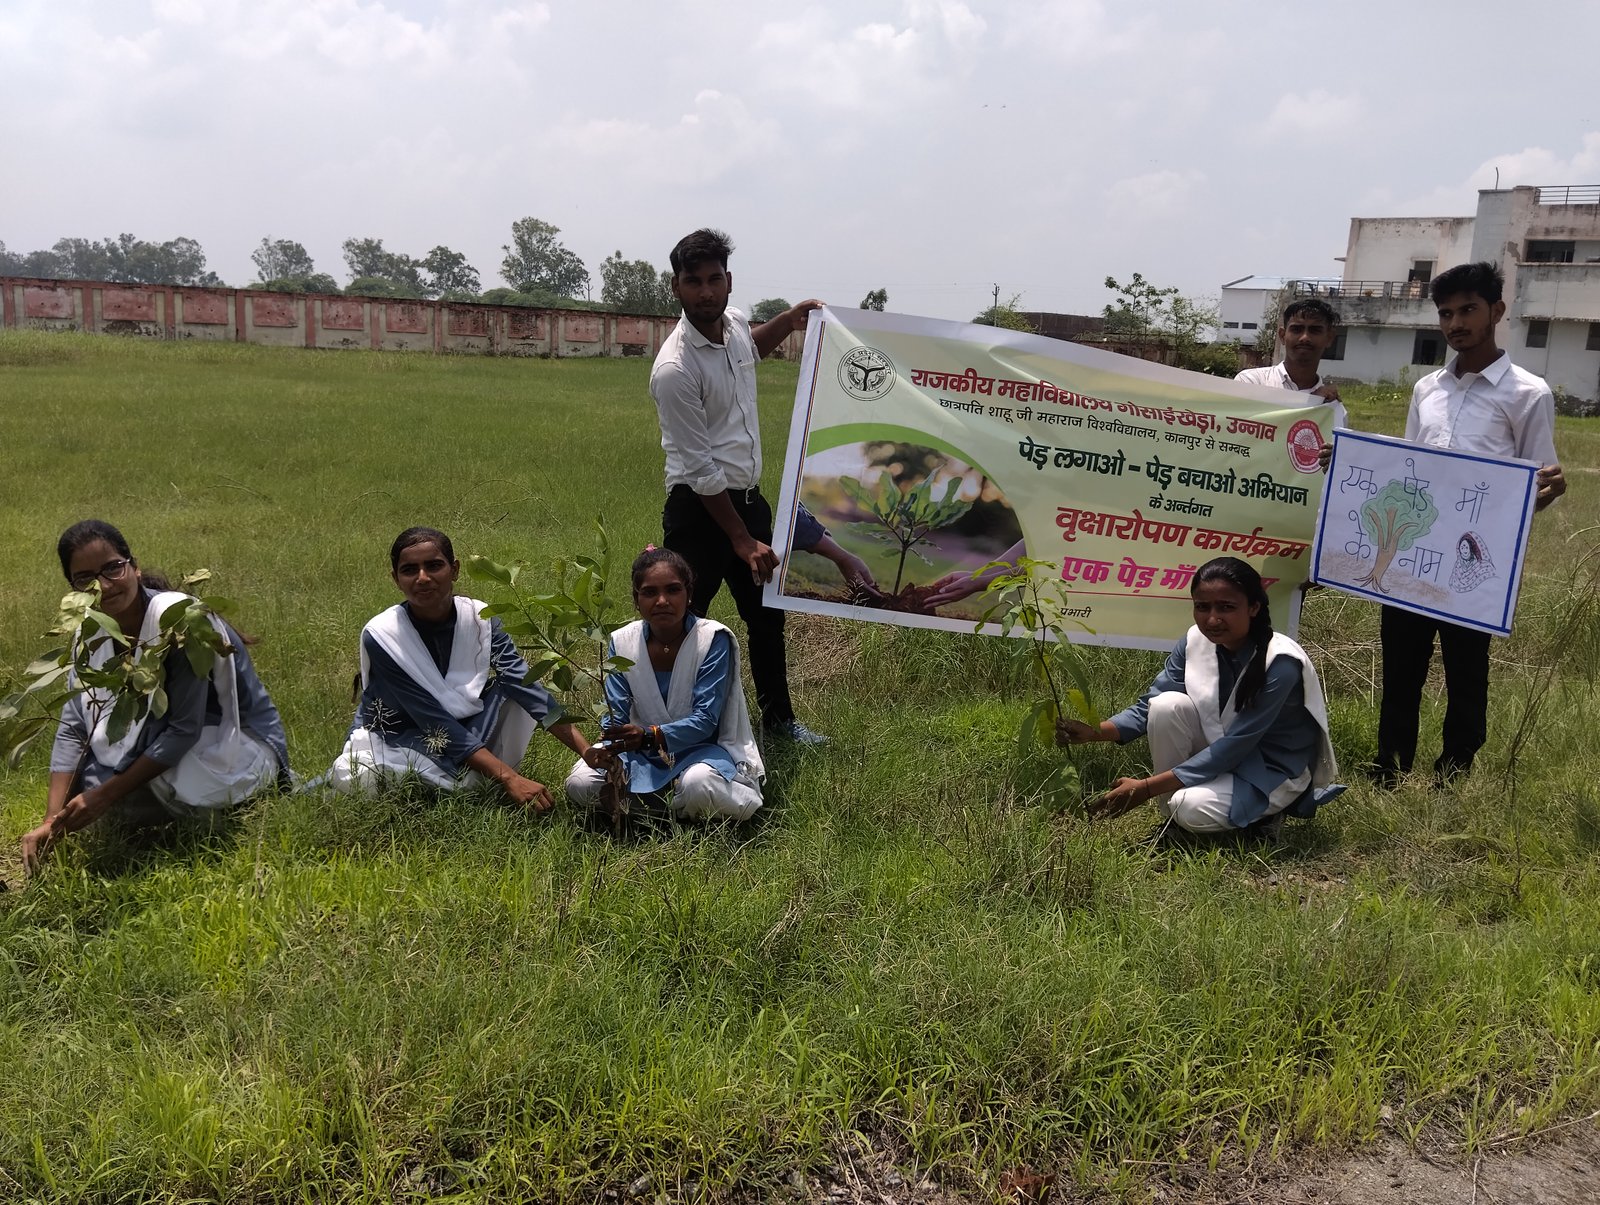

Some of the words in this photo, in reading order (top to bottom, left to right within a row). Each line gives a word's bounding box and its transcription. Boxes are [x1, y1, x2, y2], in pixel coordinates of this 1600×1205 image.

[911, 368, 995, 396] राजकीय
[1226, 416, 1277, 442] उन्नाव
[988, 407, 1013, 423] शाहू
[1016, 407, 1033, 421] जी
[1037, 412, 1083, 428] महाराज
[1087, 415, 1160, 442] विश्वविद्यालय,
[1164, 432, 1202, 450] कानपुर
[1205, 436, 1216, 450] से
[1019, 435, 1051, 470] पेड़
[1054, 447, 1126, 476] लगाओ
[1146, 455, 1175, 490] पेड़
[1177, 467, 1236, 494] बचाओ
[1237, 473, 1308, 506] अभियान
[1340, 465, 1378, 499] एक
[1149, 493, 1163, 509] के
[1055, 506, 1192, 547] वृक्षारोपण
[1193, 527, 1310, 560] कार्यक्रम
[1344, 510, 1372, 562] के
[1398, 546, 1444, 583] नाम
[1061, 556, 1114, 584] एक
[1117, 556, 1159, 593] पेड़
[1060, 606, 1092, 618] प्रभारी
